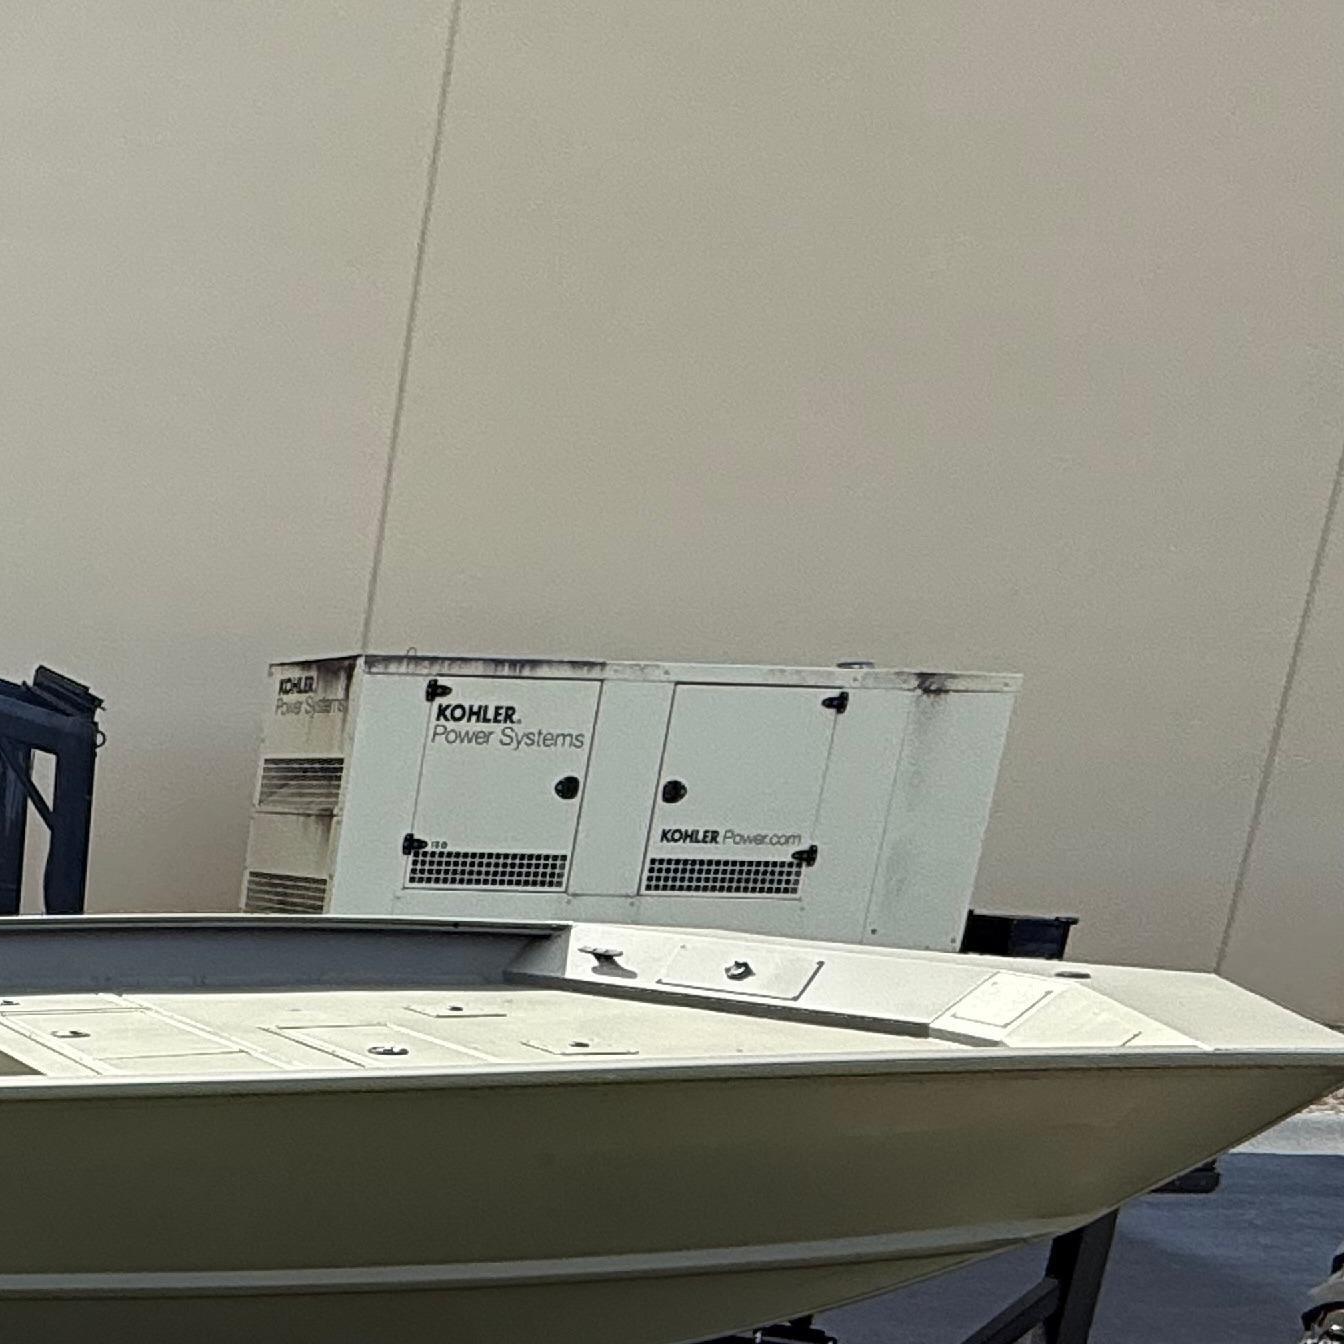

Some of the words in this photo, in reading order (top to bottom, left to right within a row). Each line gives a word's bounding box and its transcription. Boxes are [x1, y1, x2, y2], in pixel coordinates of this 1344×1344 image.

[435, 703, 517, 725] KOHLER
[431, 724, 495, 746] Power
[498, 726, 586, 751] Systems
[660, 828, 720, 844] KOHLER
[723, 829, 802, 846] Power.com
